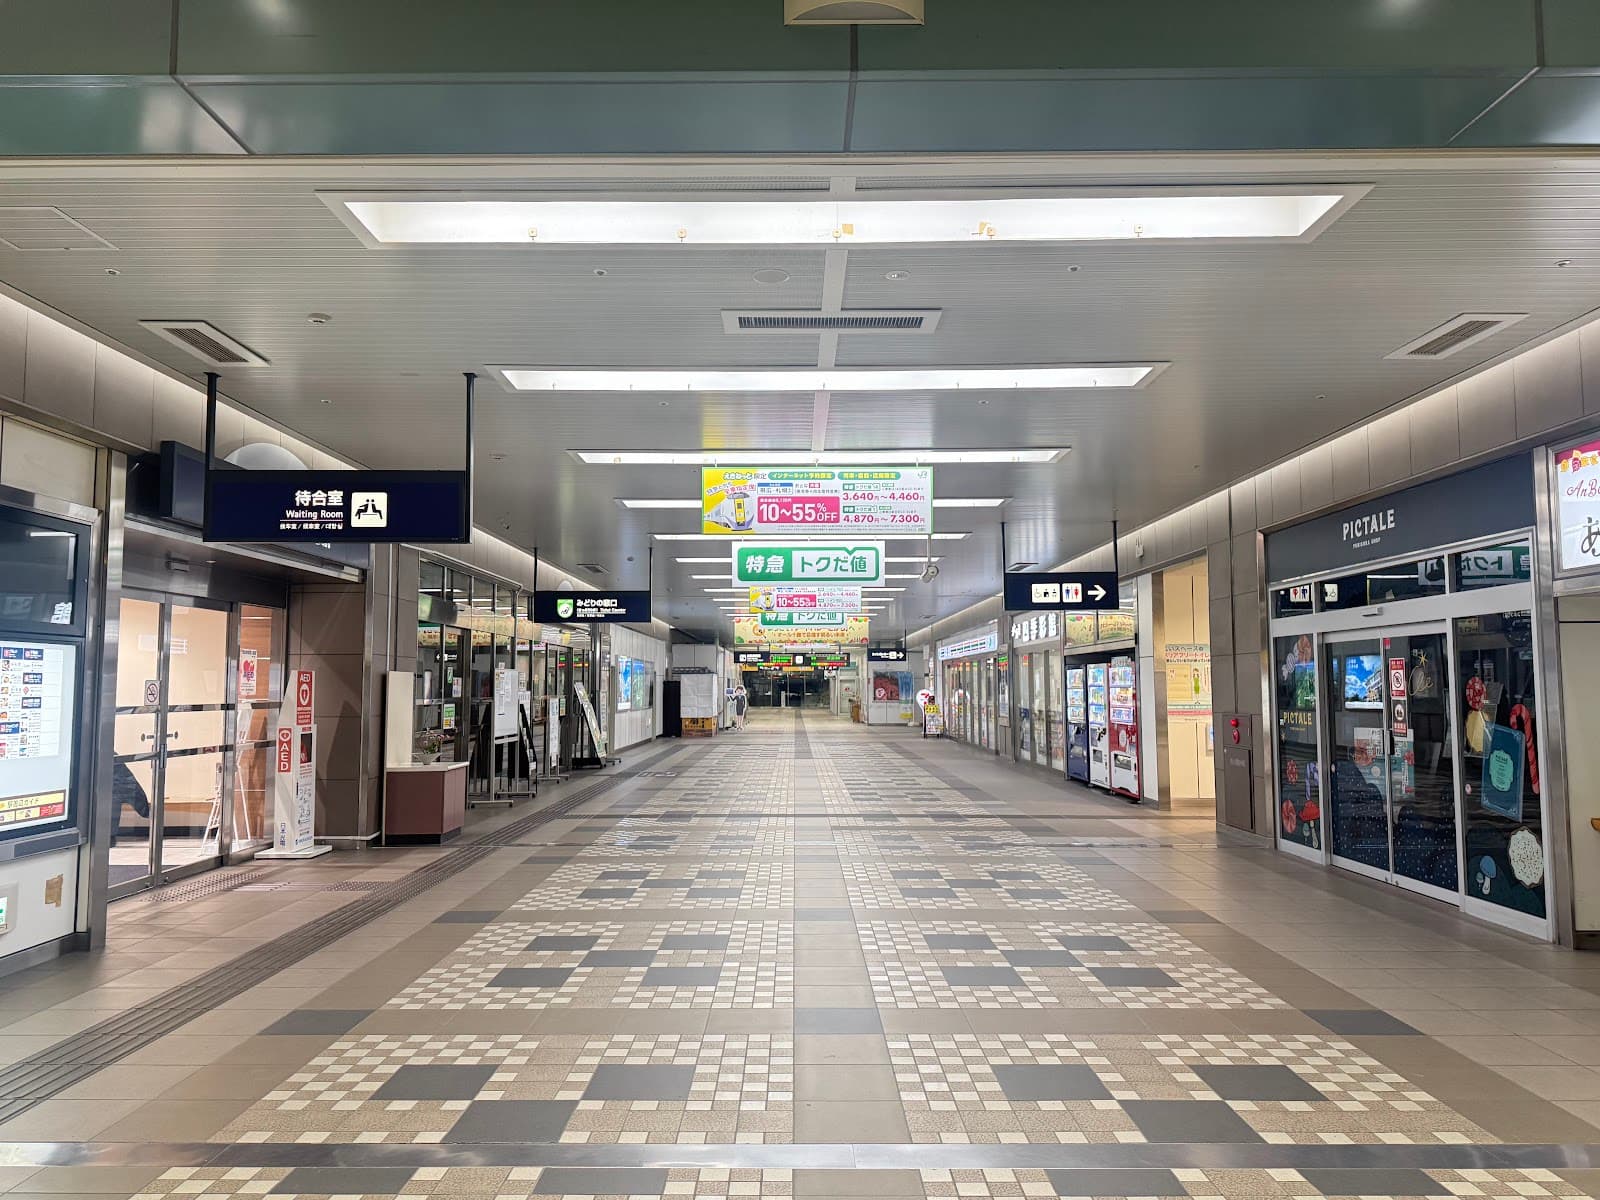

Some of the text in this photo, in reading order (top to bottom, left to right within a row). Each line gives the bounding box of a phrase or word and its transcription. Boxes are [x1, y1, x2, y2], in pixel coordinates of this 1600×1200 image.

[295, 490, 344, 506] 待合室
[286, 510, 344, 520] Waiting Room
[817, 512, 838, 521] OFF
[1343, 509, 1395, 541] PICTALE
[746, 555, 868, 574] 特急 トクだ値
[576, 599, 618, 607] みどりの窓口
[300, 673, 311, 681] AED
[1283, 711, 1313, 725] PICTALE
[280, 742, 290, 771] AED
